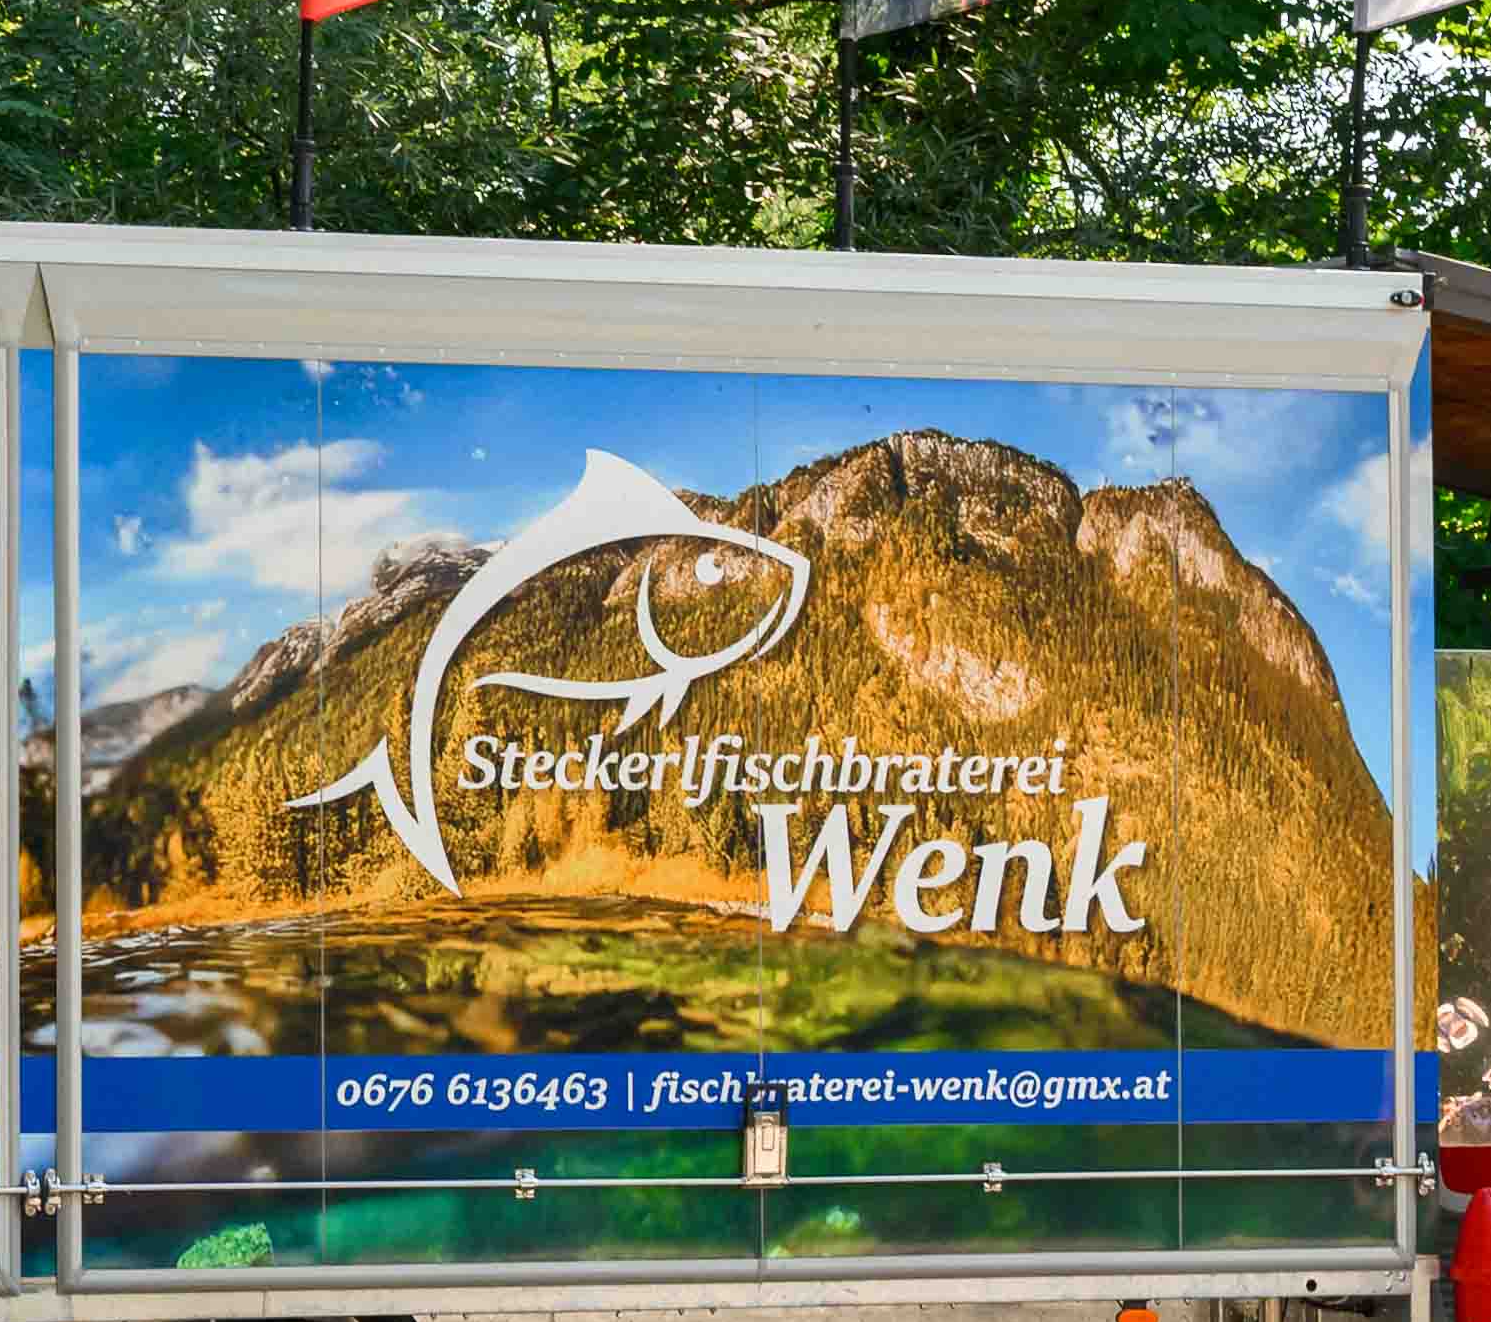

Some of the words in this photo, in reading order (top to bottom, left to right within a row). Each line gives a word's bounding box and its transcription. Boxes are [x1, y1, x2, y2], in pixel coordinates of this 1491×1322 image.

[456, 732, 1066, 808] Steckerlfischbraterei
[753, 796, 1148, 934] Wenk
[337, 1074, 433, 1107] 0676
[447, 1073, 608, 1110] 6136463
